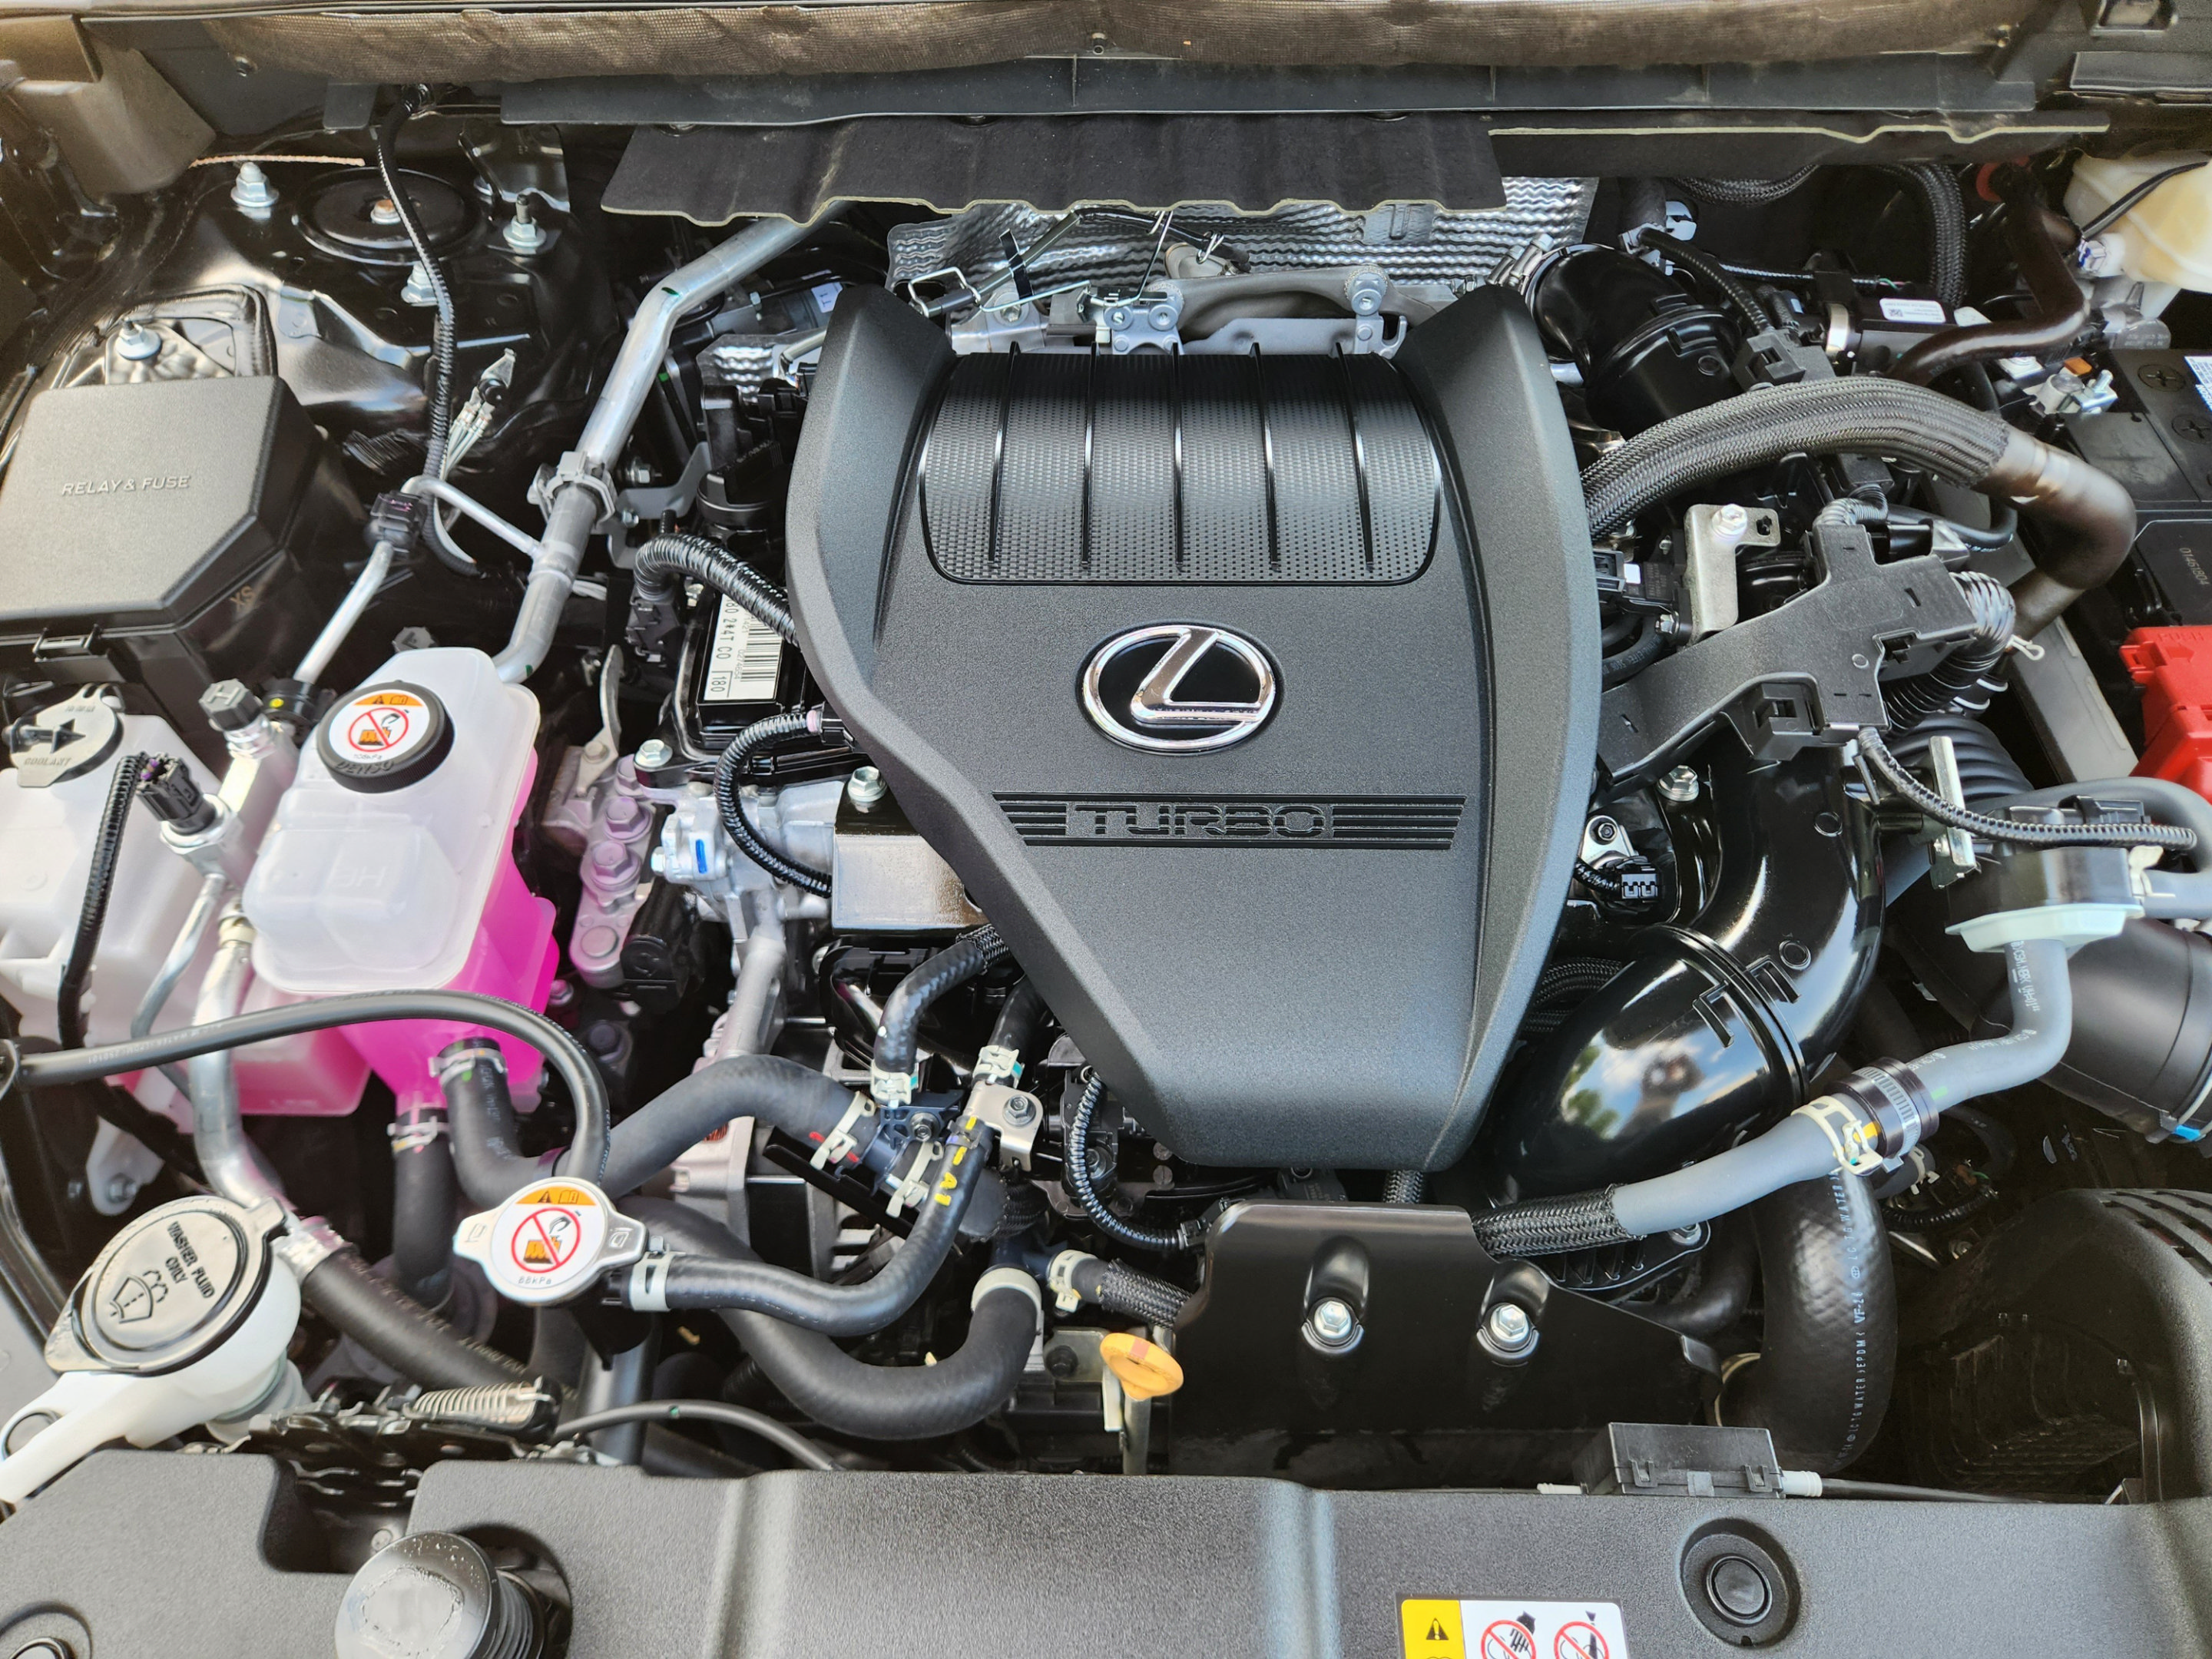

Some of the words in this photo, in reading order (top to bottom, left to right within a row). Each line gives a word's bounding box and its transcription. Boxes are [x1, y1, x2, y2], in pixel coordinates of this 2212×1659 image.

[61, 479, 122, 496] RELAY
[123, 478, 136, 492] &
[141, 475, 191, 491] FUSE
[207, 684, 241, 706] H
[710, 676, 727, 692] 180
[24, 757, 72, 767] COOLANT
[336, 760, 395, 774] DENSO
[1075, 804, 1324, 836] TURBO
[1832, 1185, 1850, 1222] WATER
[165, 1257, 188, 1283] ONLY
[167, 1221, 198, 1267] WASHER
[191, 1266, 215, 1299] FLUID
[1854, 1378, 1866, 1409] WATER
